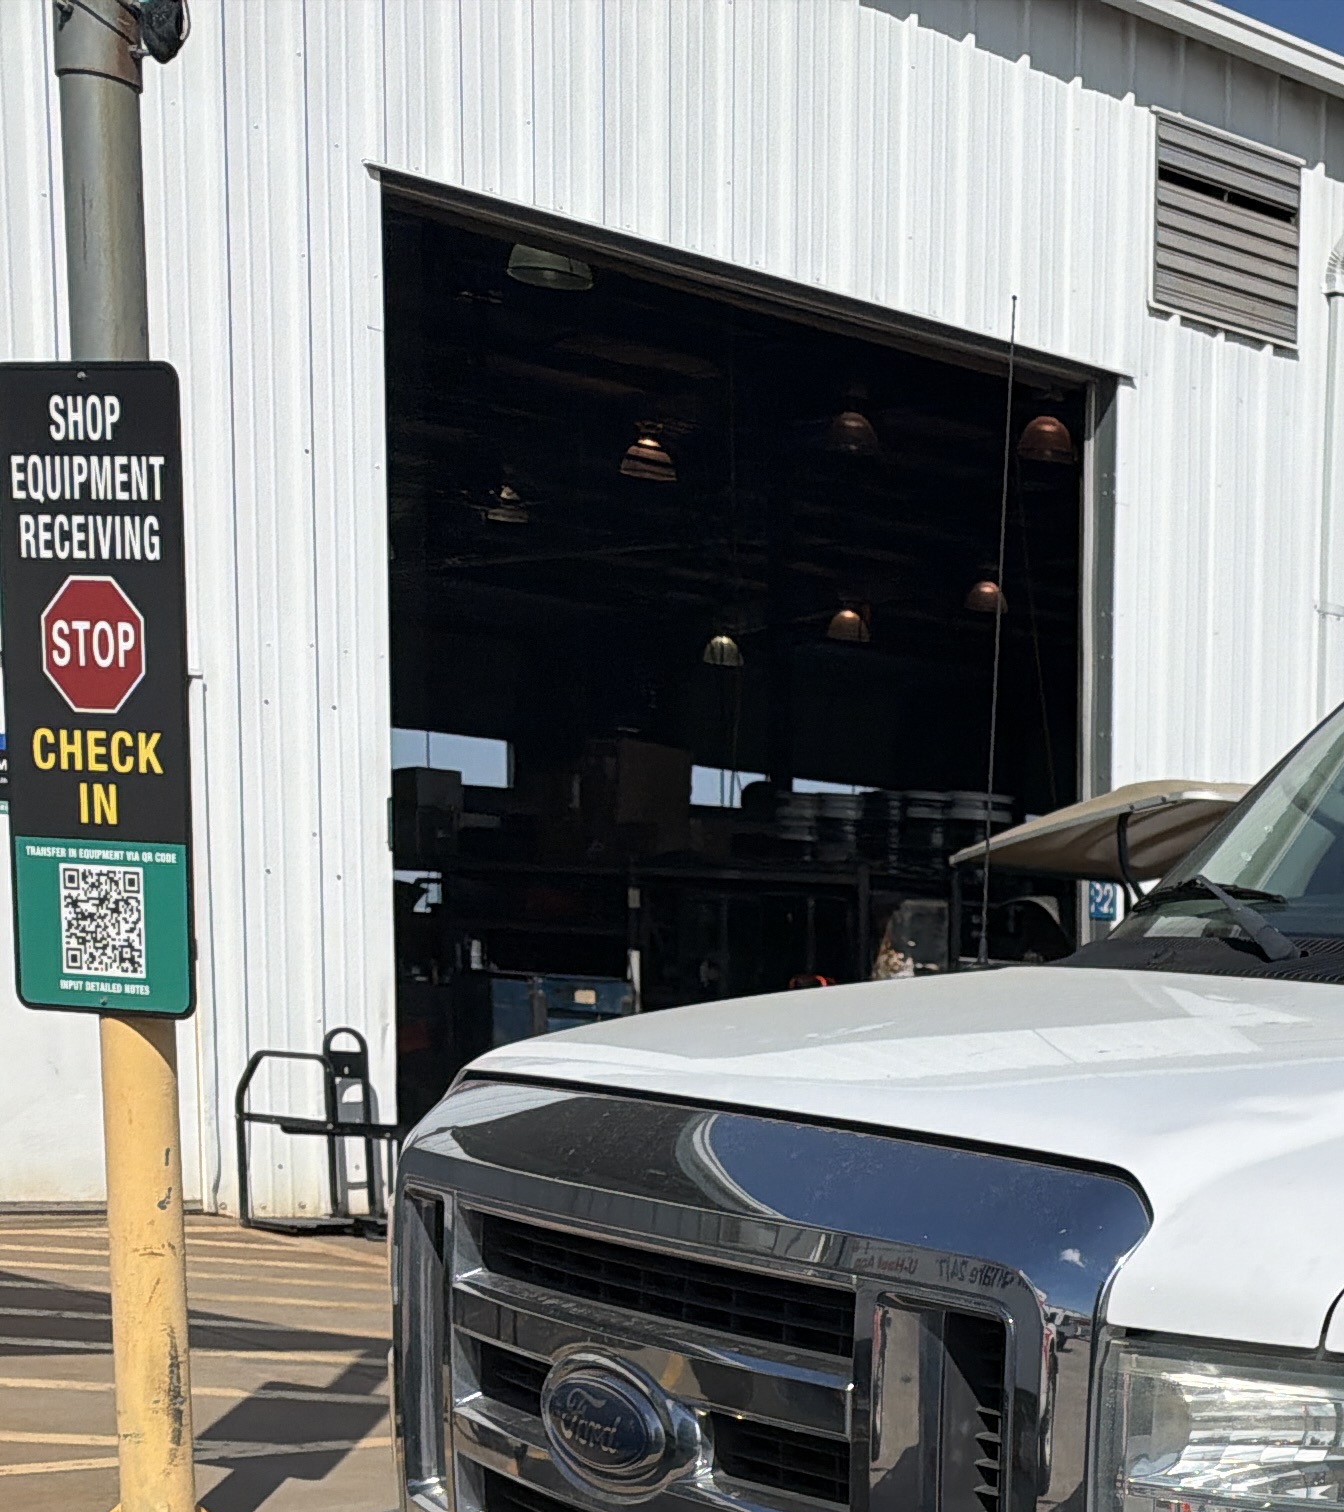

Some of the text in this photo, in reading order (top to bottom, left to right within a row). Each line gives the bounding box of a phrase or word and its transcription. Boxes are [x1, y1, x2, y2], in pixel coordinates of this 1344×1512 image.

[49, 394, 121, 441] SHOP
[10, 454, 165, 504] EQUIPMENT
[19, 513, 161, 561] RECEIVING
[52, 619, 135, 668] STOP
[32, 727, 164, 775] CHECK
[79, 782, 118, 825] IN
[25, 845, 177, 864] TRANSFER IN EQUIPMENT VIA QR CODE
[60, 979, 150, 996] INPUT DETAILED NOTES
[560, 1387, 625, 1455] Ford
